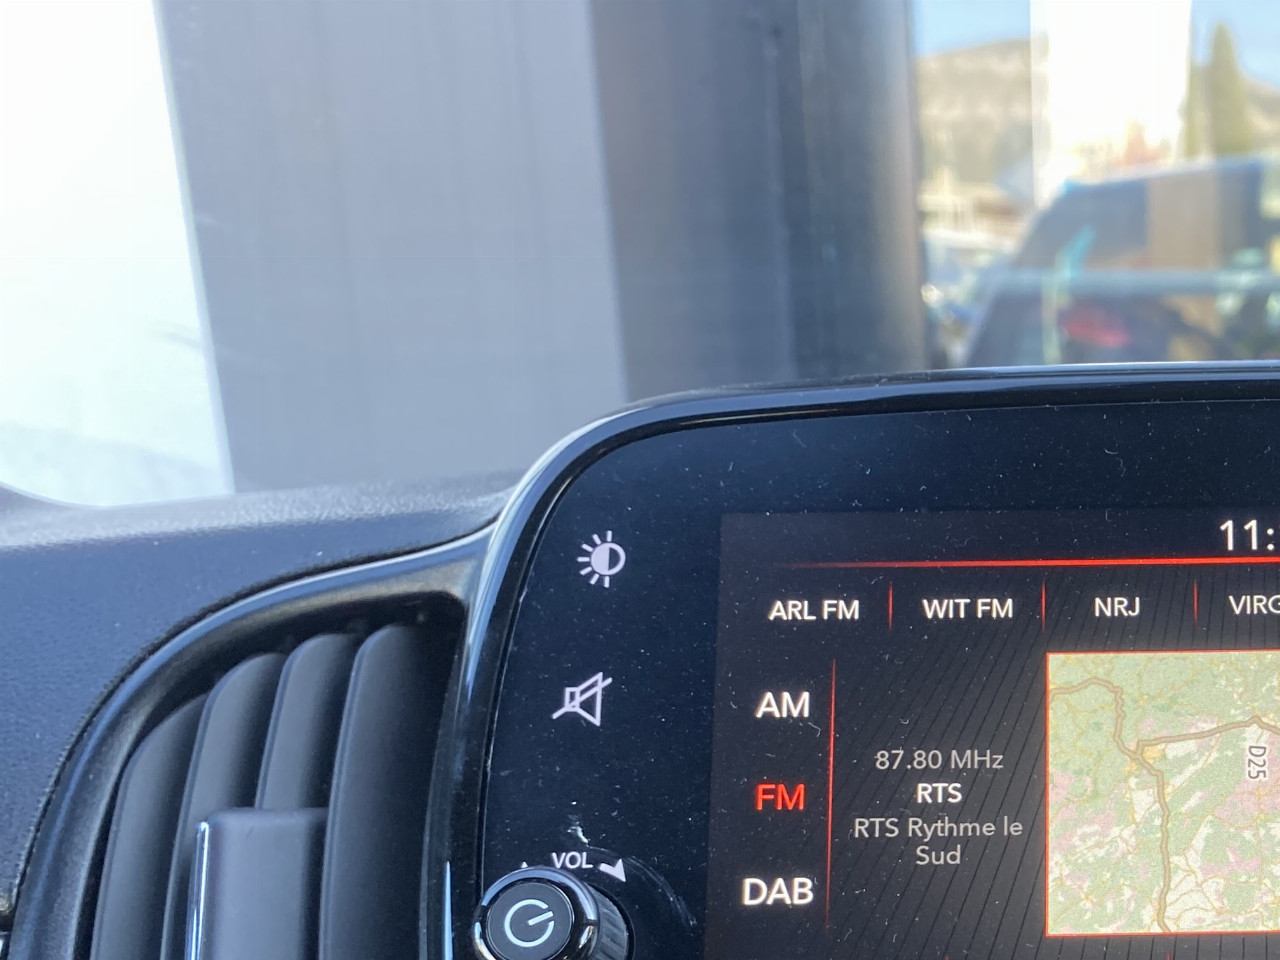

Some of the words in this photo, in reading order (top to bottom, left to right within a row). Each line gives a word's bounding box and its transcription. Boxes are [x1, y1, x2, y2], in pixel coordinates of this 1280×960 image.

[769, 600, 816, 620] ARL
[822, 600, 860, 620] FM
[923, 599, 970, 619] WIT
[977, 599, 1013, 619] FM
[1094, 597, 1142, 619] NRJ
[755, 691, 811, 719] AM
[874, 749, 942, 771] 87.80
[949, 750, 1004, 770] MHz
[1247, 746, 1268, 781] D25
[756, 783, 806, 811] FM
[916, 783, 962, 804] RTS
[854, 818, 899, 839] RTS
[907, 817, 995, 845] Rythme
[1003, 816, 1023, 837] le
[552, 851, 594, 870] VOL
[916, 845, 961, 865] Sud
[742, 878, 814, 906] DAB
